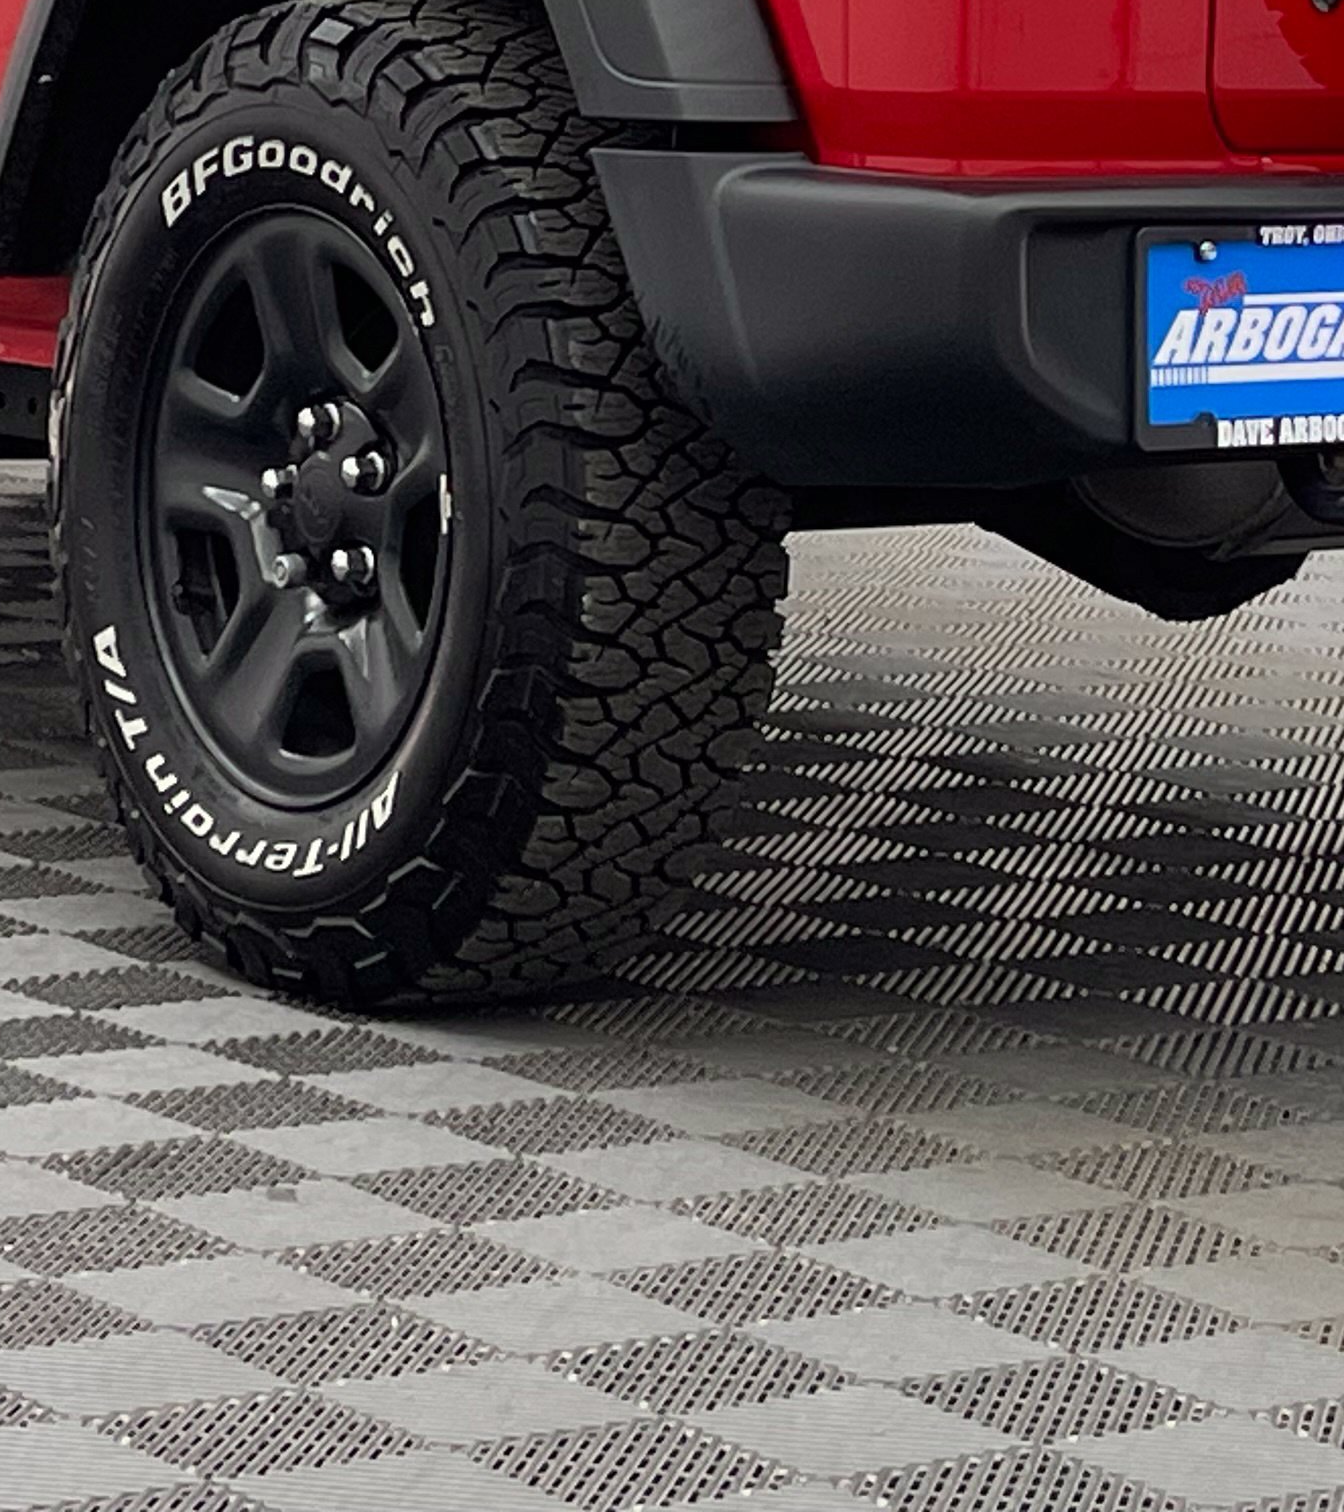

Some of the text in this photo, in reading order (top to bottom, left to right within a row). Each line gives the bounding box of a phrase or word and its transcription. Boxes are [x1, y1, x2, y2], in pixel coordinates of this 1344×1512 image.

[160, 133, 437, 329] BFGoodrich
[1217, 417, 1275, 448] DAVE
[91, 623, 401, 879] All-Terrain T/A
